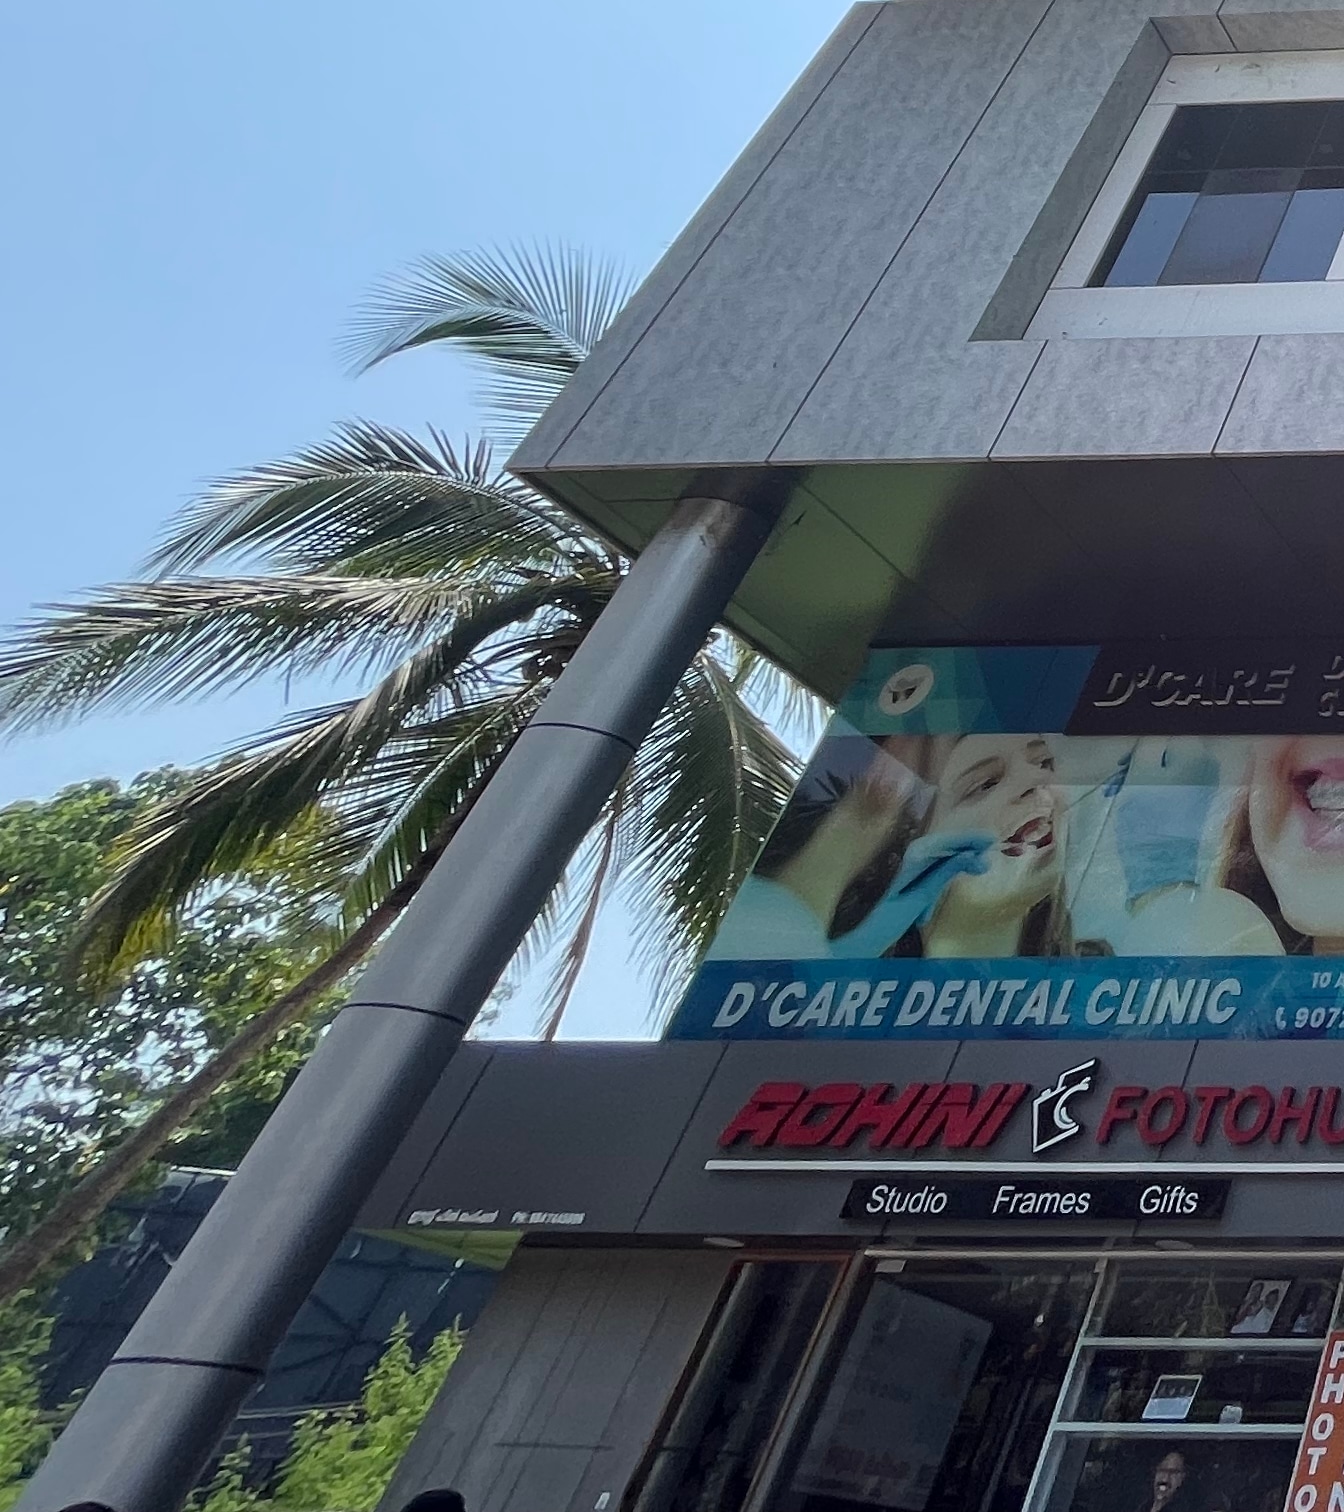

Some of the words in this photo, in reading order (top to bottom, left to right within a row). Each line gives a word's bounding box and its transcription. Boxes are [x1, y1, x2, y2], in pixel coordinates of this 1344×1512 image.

[1312, 972, 1332, 988] 10
[711, 980, 899, 1029] D'CARE
[894, 978, 1072, 1027] DENTAL
[1083, 977, 1243, 1026] CLINIC
[866, 1185, 948, 1215] Studio
[992, 1185, 1091, 1215] Frames
[1139, 1185, 1200, 1215] Gifts
